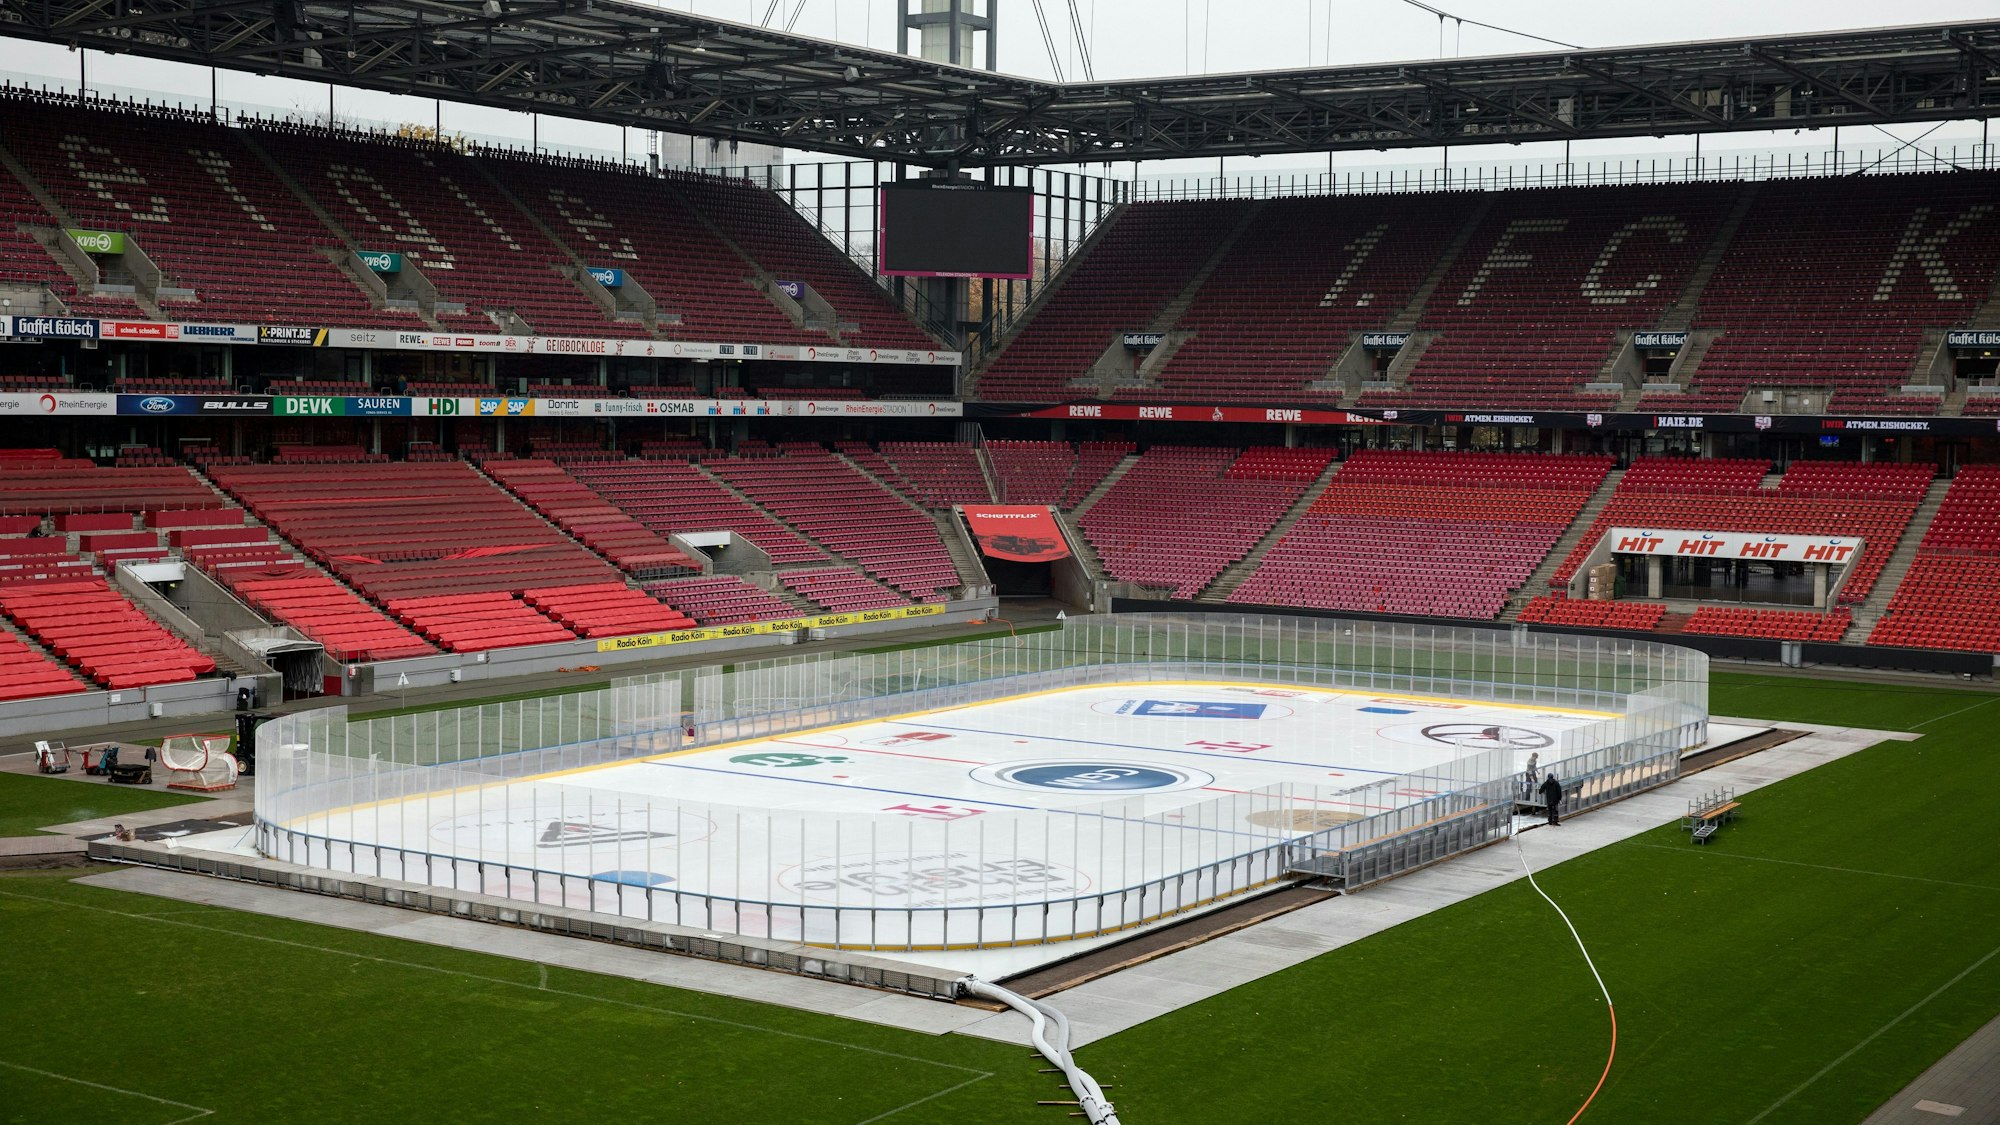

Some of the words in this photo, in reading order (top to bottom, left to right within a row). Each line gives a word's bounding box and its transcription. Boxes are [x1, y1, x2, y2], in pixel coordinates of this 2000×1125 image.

[19, 318, 54, 335] Gaffel
[56, 319, 94, 337] Kölsch
[184, 326, 235, 336] LIEBHERR
[261, 327, 311, 339] X-PRINT.DE
[350, 333, 376, 343] seitz
[1124, 335, 1144, 346] Gaffel
[1364, 335, 1385, 346] Gaffel
[1635, 334, 1660, 345] Gaffel
[1948, 333, 1976, 344] Gaffel
[59, 400, 107, 410] RheinEnergie
[147, 400, 168, 410] Ford
[286, 398, 332, 414] DEVK
[358, 398, 400, 408] SAUREN
[428, 398, 459, 415] HDI
[480, 401, 498, 413] SAP
[508, 401, 525, 413] SAP
[548, 400, 579, 408] Dorint
[606, 402, 642, 412] funny-frisch
[660, 403, 694, 413] OSMAB
[1069, 405, 1101, 416] REWE
[1140, 406, 1172, 418] REWE
[1266, 409, 1302, 421] REWE
[1658, 417, 1703, 427] HAIE.DE
[790, 621, 803, 629] Köln
[723, 628, 740, 636] Radio
